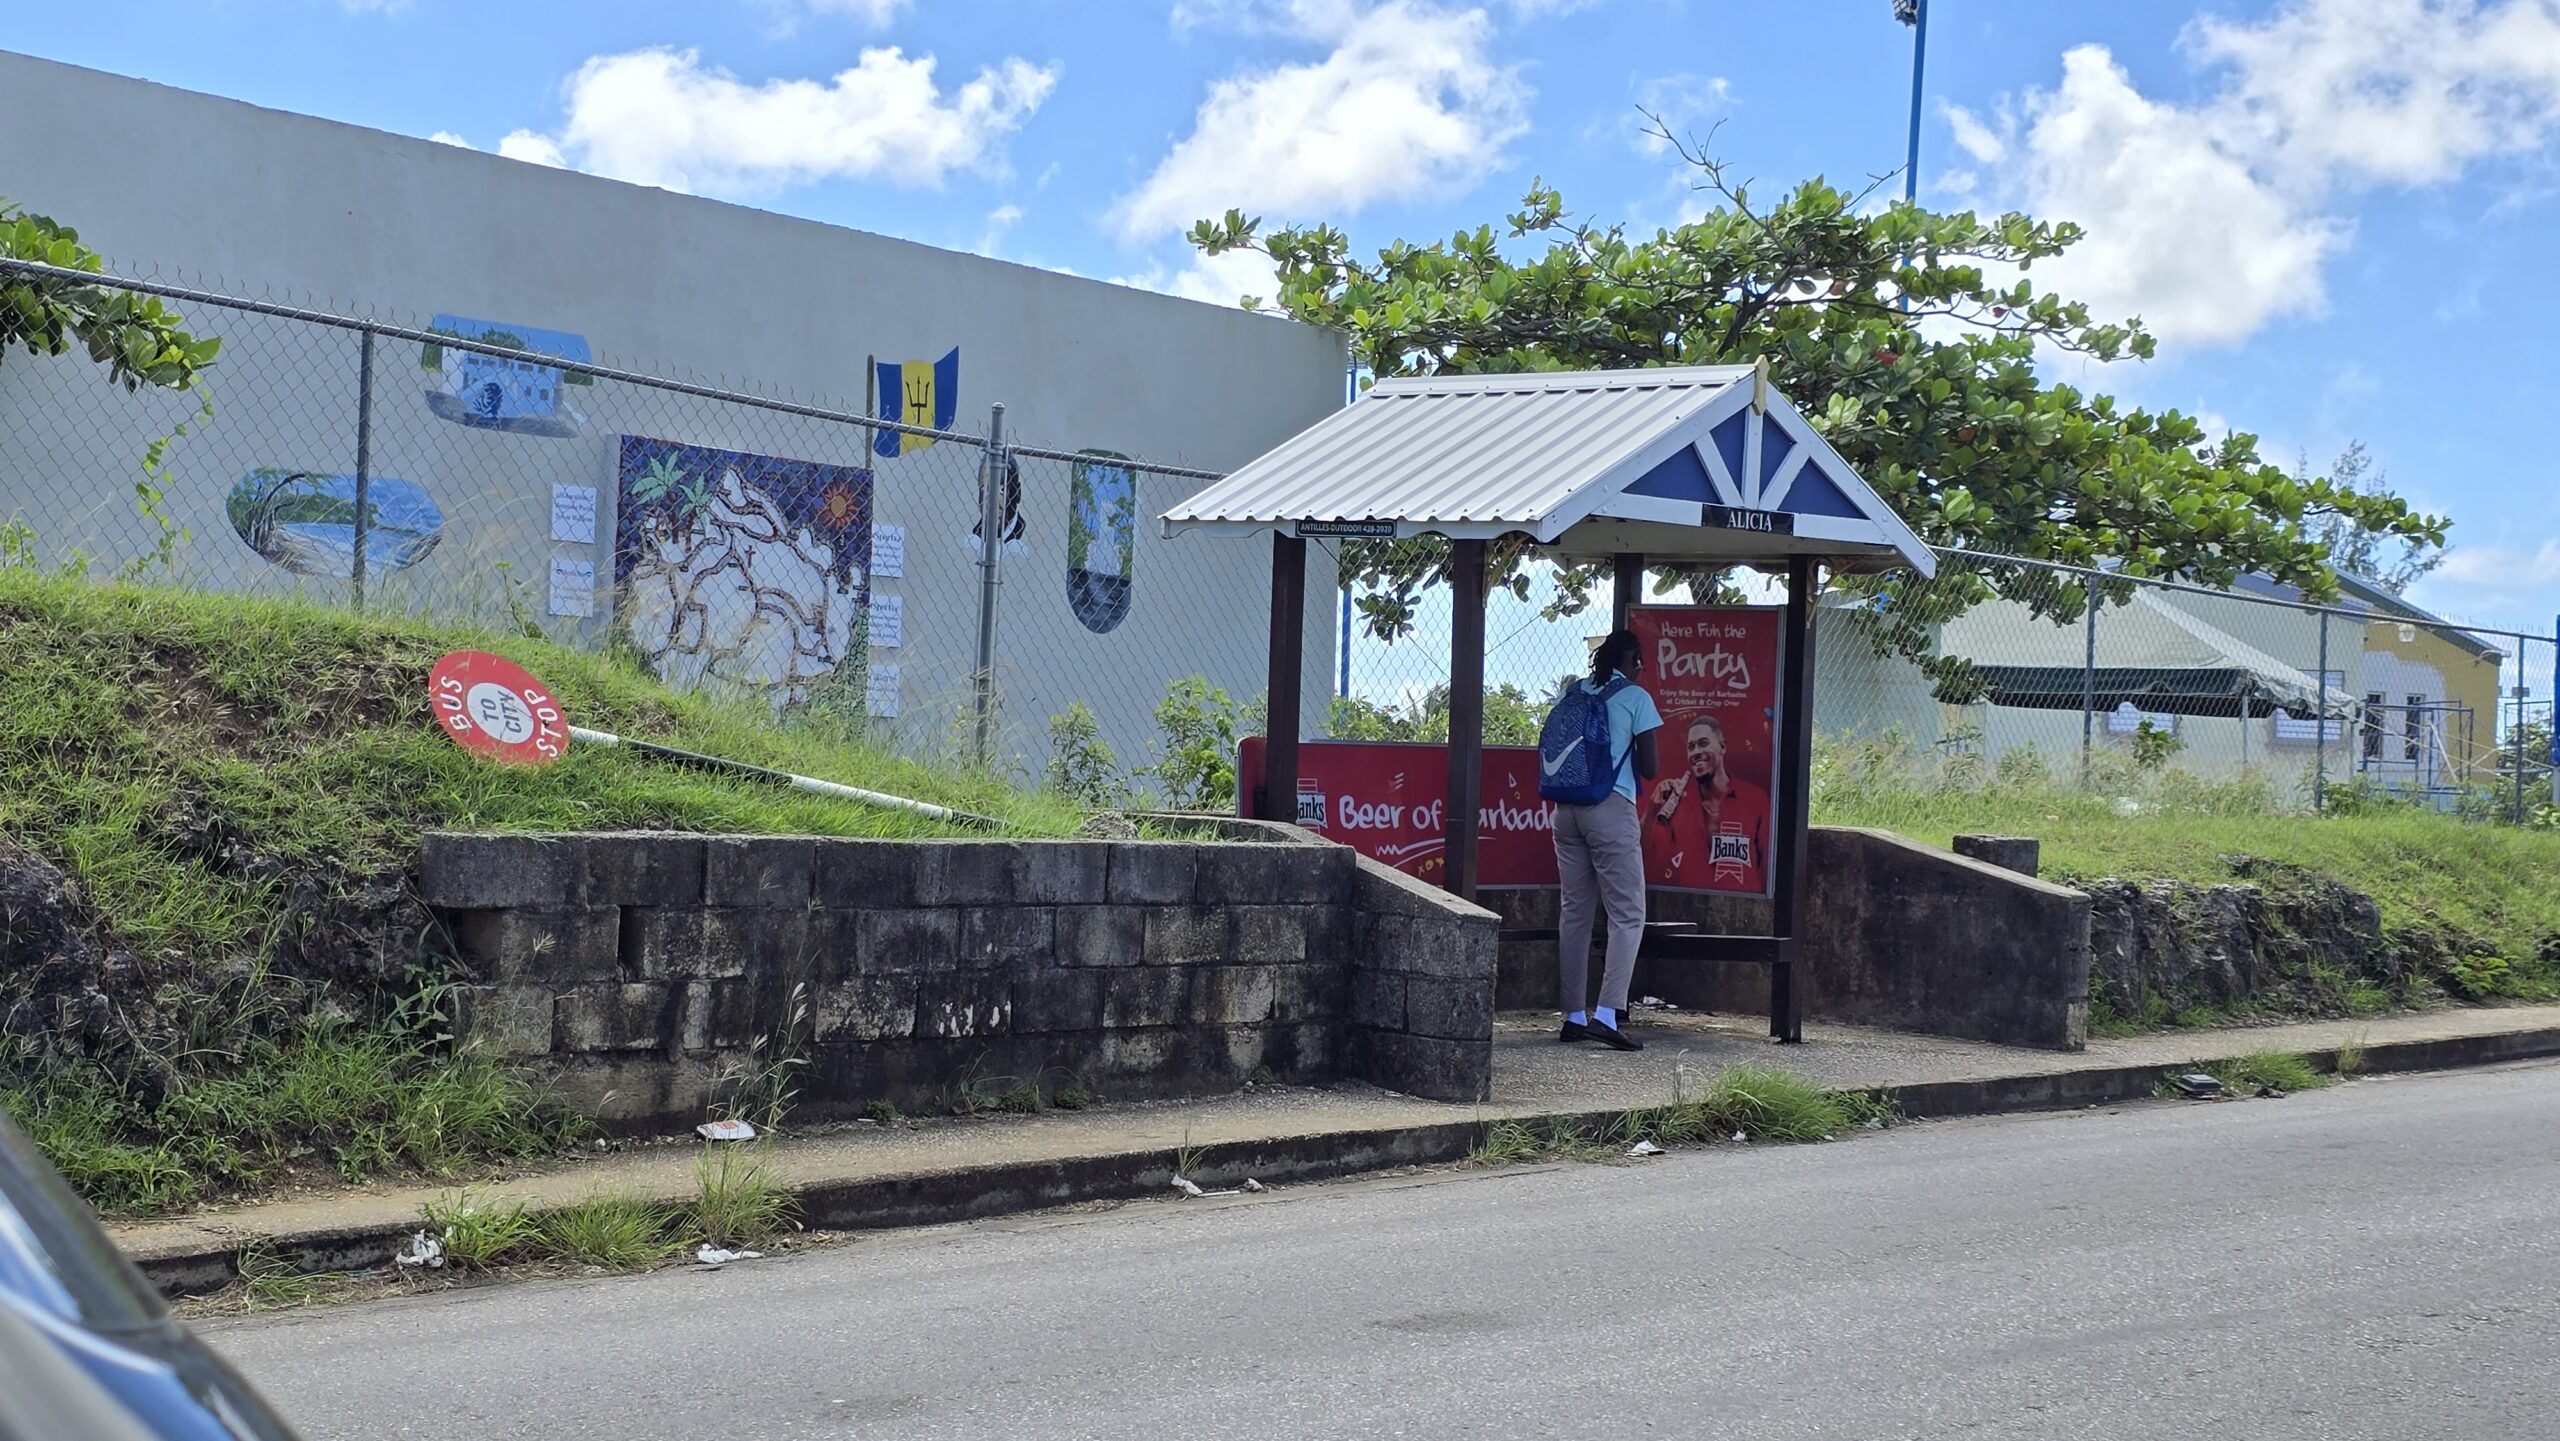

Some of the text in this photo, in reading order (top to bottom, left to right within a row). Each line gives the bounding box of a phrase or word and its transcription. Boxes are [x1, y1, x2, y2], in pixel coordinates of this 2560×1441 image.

[1300, 523, 1330, 532] ANTILLES
[1330, 523, 1362, 533] OUTDOOR
[1727, 511, 1772, 532] ALICIA
[1661, 621, 1746, 638] Here Fuh the
[1657, 638, 1750, 689] Party
[440, 676, 472, 731] BUS
[480, 698, 500, 722] TO
[498, 690, 522, 734] CITY
[524, 689, 562, 758] STOP
[1297, 796, 1325, 822] anks
[1339, 794, 1406, 830] Beer
[1412, 798, 1442, 831] of
[1713, 837, 1749, 861] Banks
